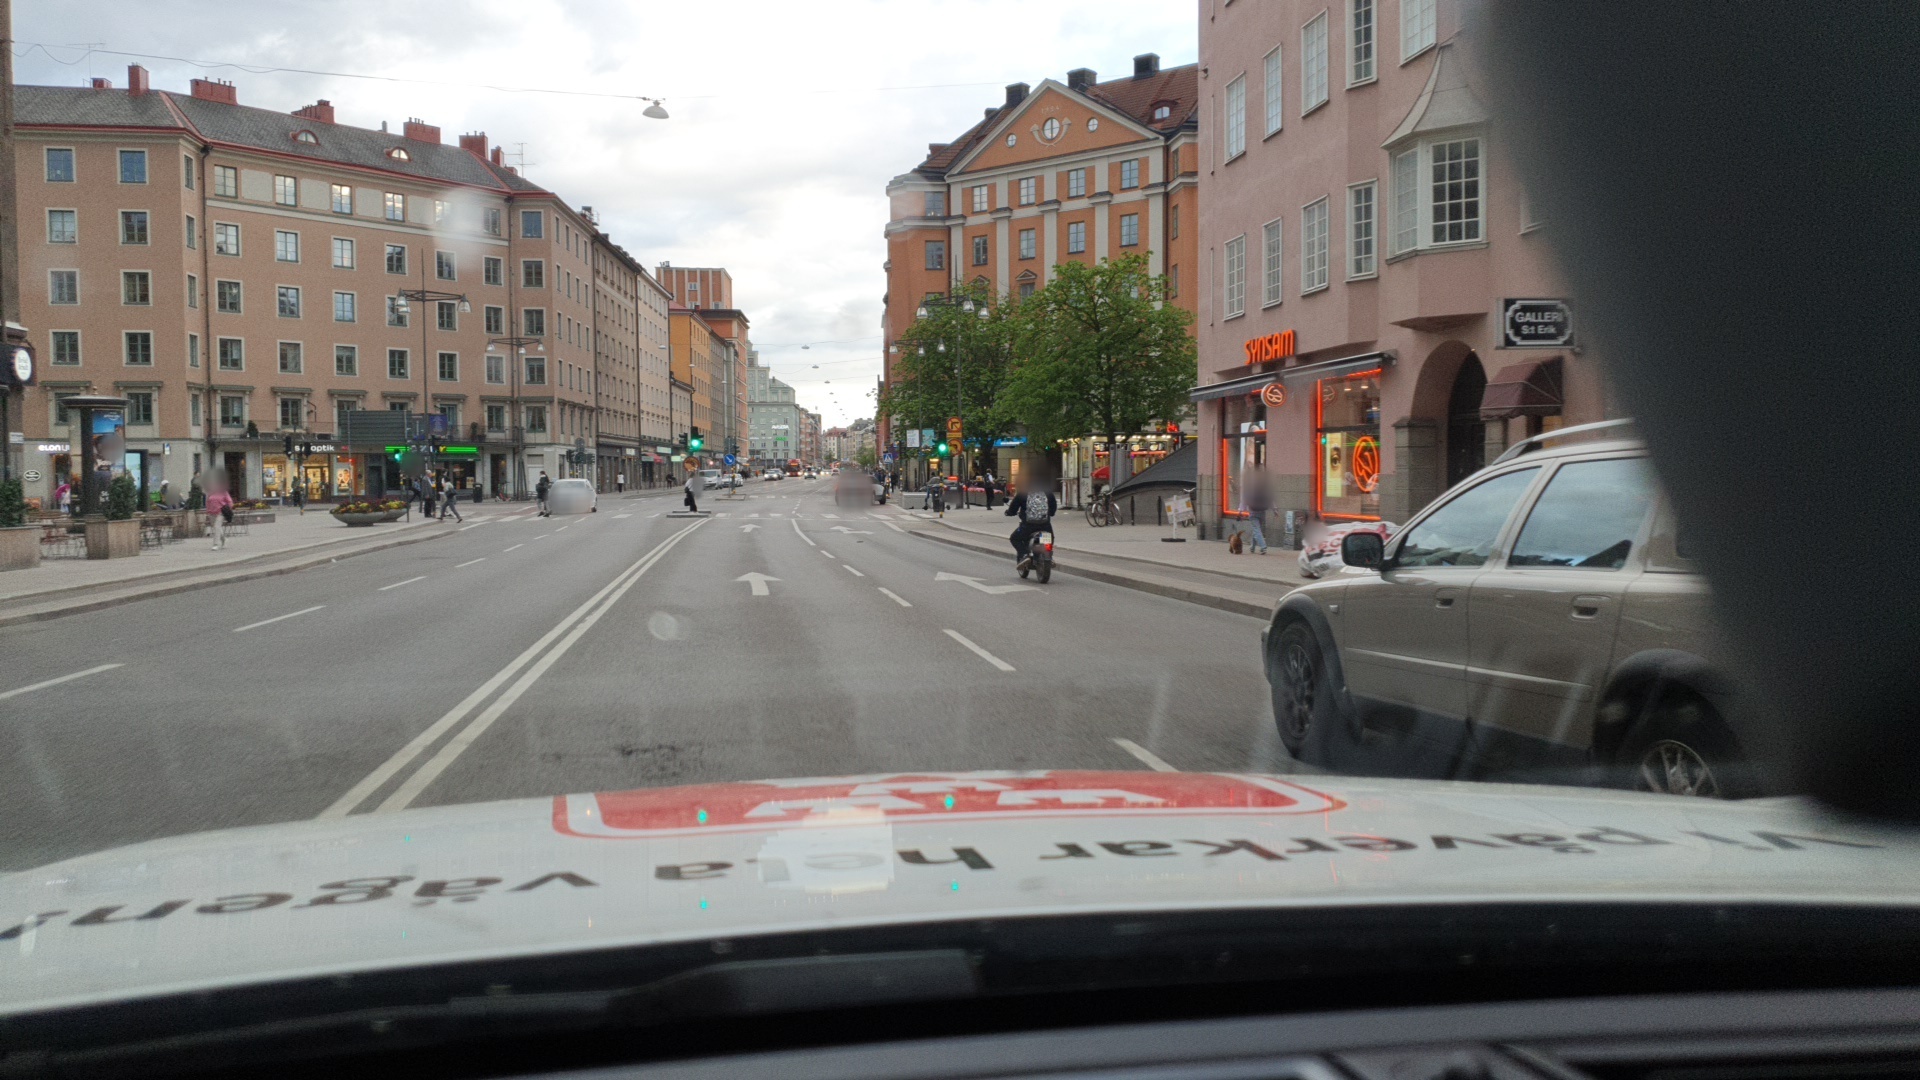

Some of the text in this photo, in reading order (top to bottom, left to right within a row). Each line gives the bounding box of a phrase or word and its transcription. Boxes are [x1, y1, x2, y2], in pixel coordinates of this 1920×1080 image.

[1515, 311, 1565, 323] GALLERI
[1537, 325, 1557, 334] Erik
[1244, 329, 1295, 365] SYNSAM
[294, 445, 335, 453] soptik
[1037, 825, 1673, 863] påverkar
